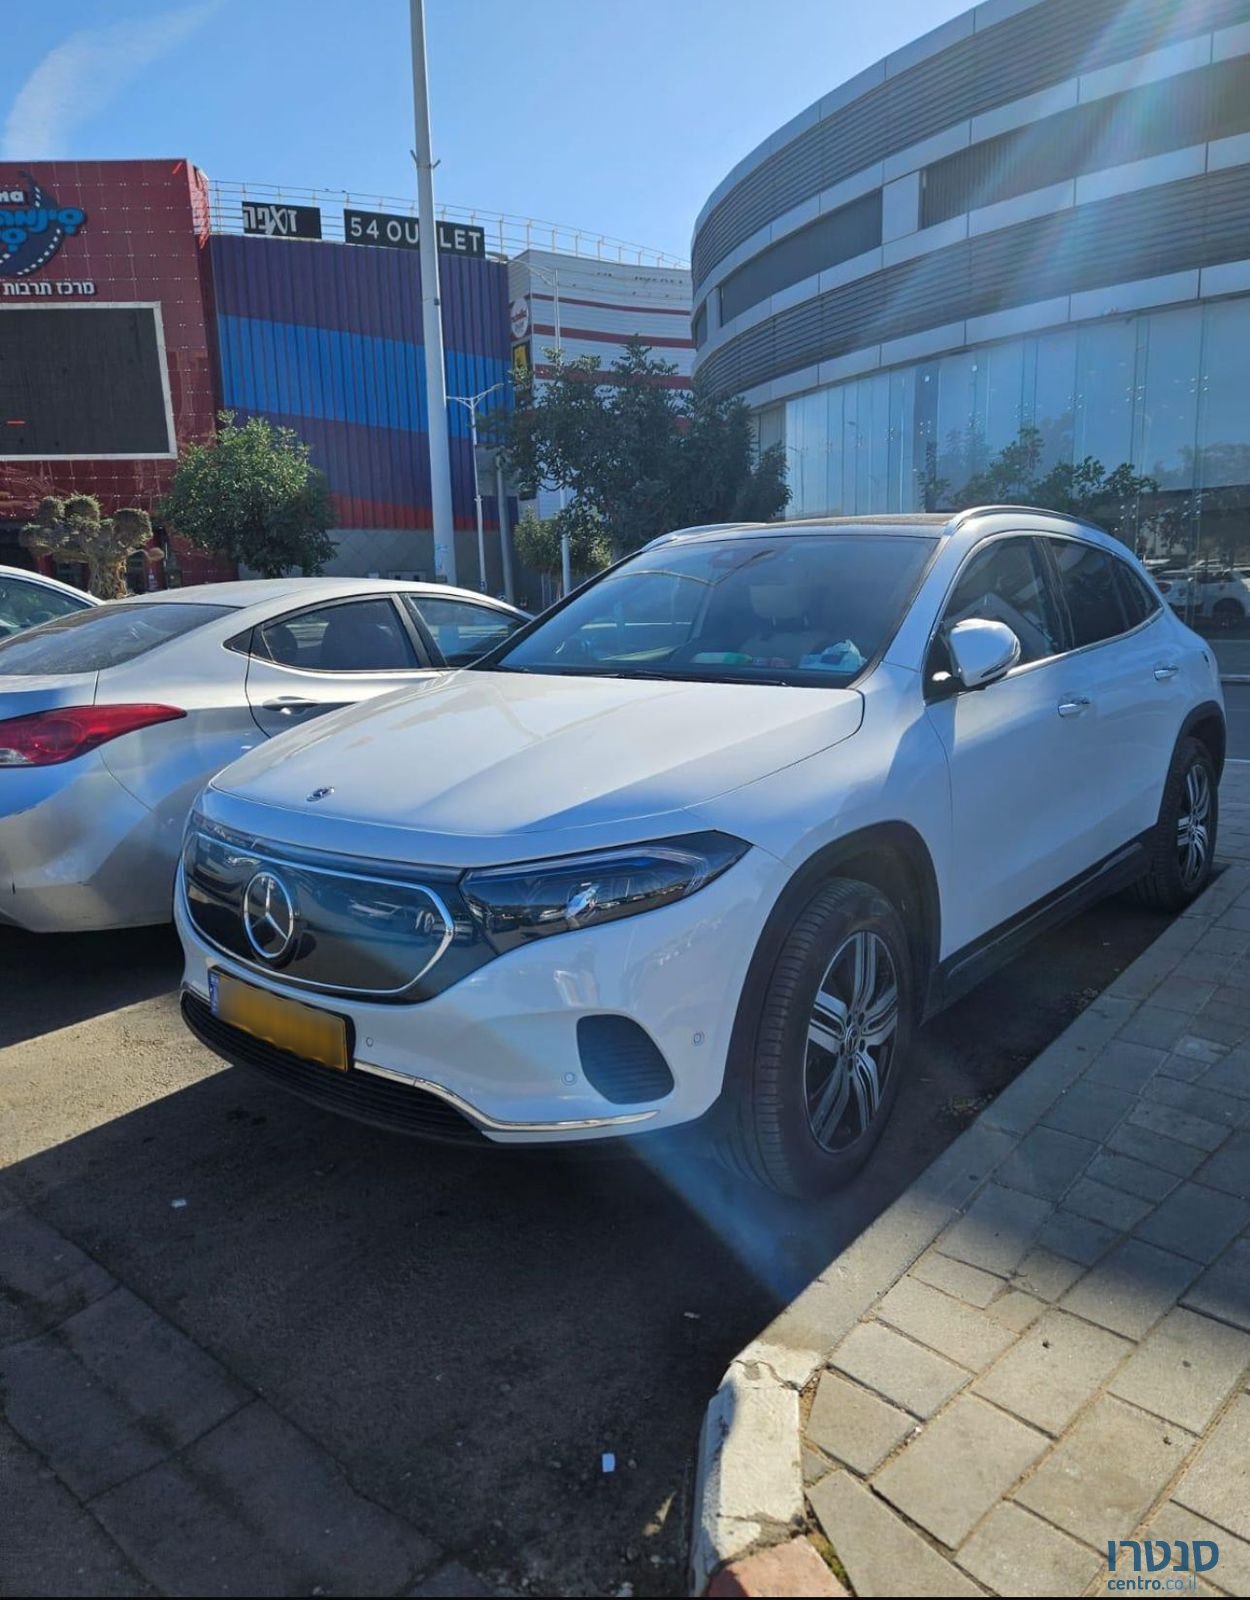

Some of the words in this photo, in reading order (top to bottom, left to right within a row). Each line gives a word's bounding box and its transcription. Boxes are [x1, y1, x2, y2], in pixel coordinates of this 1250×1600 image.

[351, 217, 379, 239] 54
[387, 220, 481, 252] OULET
[2, 282, 52, 296] תרבות
[56, 282, 95, 295] מרכז
